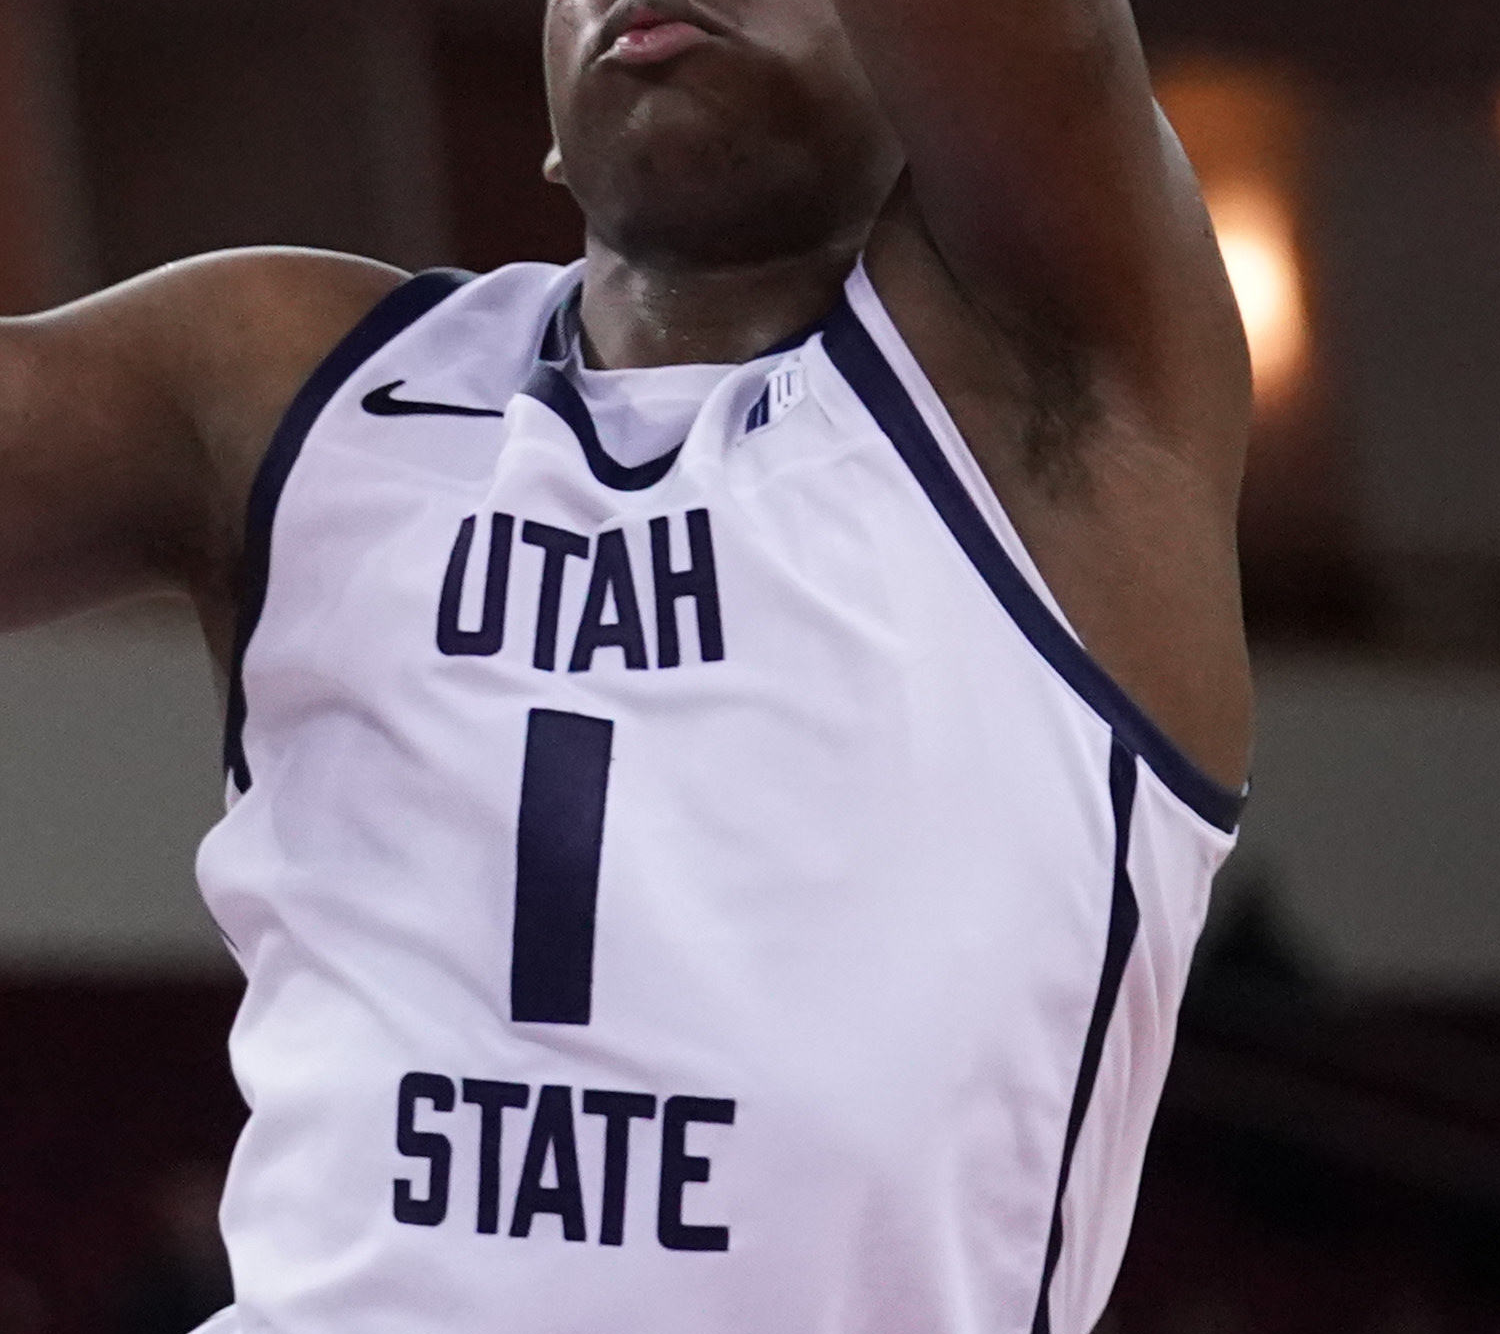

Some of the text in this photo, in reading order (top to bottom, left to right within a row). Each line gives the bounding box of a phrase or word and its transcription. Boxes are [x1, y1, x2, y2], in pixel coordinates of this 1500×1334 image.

[436, 508, 725, 673] UTAH
[510, 707, 615, 1026] 1
[393, 1070, 737, 1252] STATE
